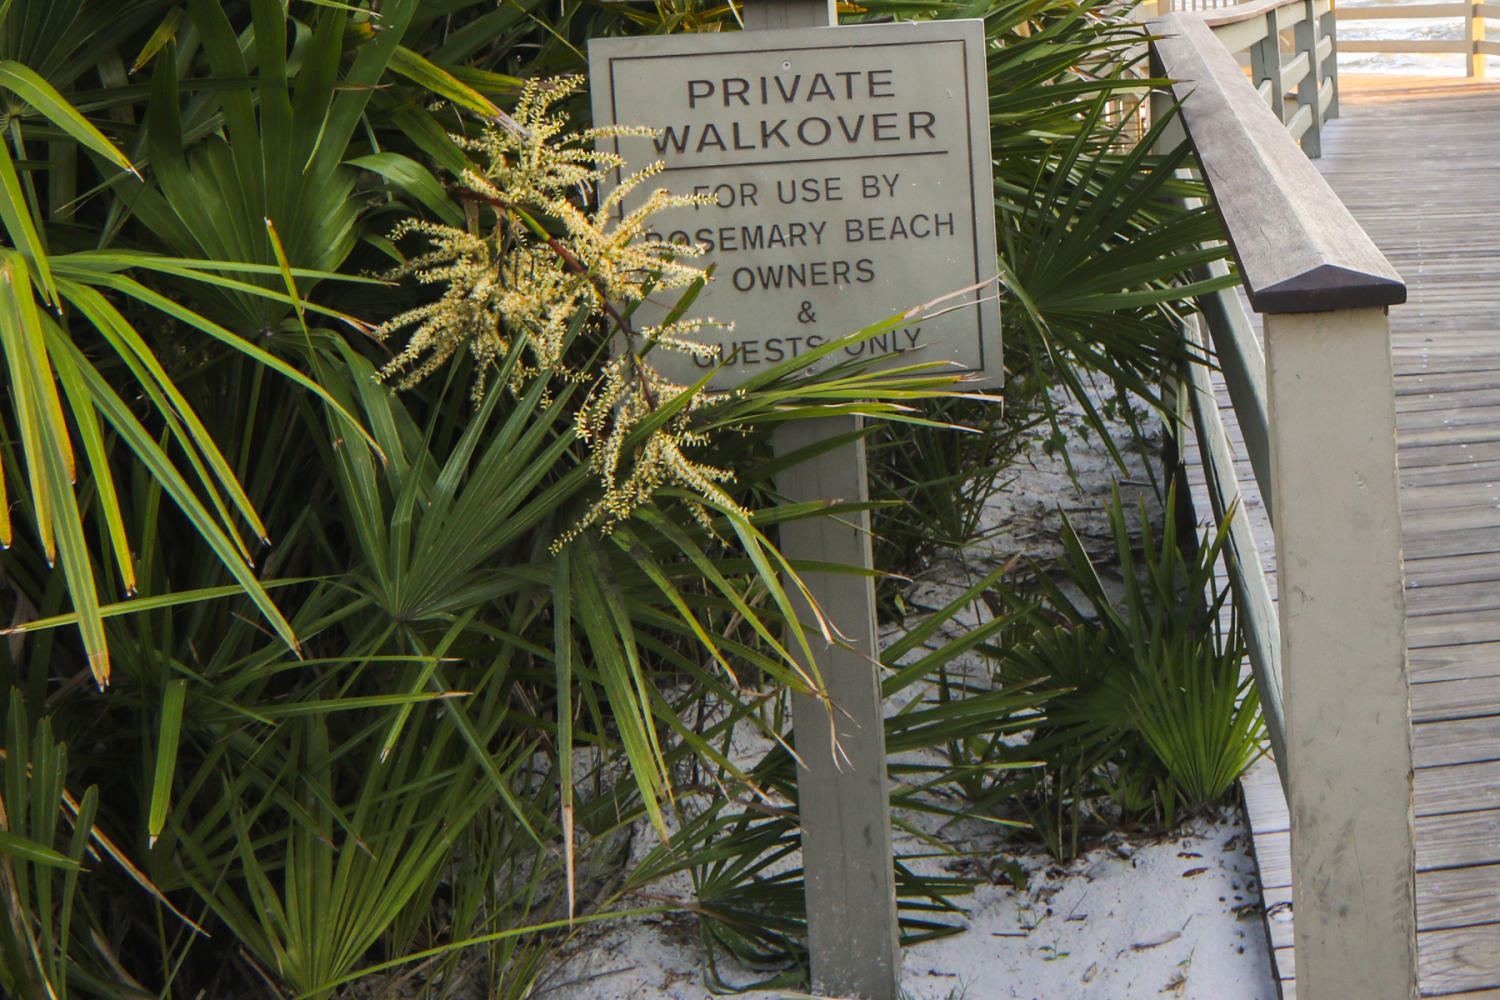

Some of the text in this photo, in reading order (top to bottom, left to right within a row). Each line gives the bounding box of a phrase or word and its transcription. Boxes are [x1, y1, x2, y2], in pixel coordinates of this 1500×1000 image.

[687, 69, 896, 109] PRIVATE
[652, 110, 937, 155] WALKOVER
[692, 173, 900, 211] FOR USE BY
[845, 212, 955, 243] BEACH
[732, 258, 876, 292] OWNERS
[797, 300, 817, 324] &
